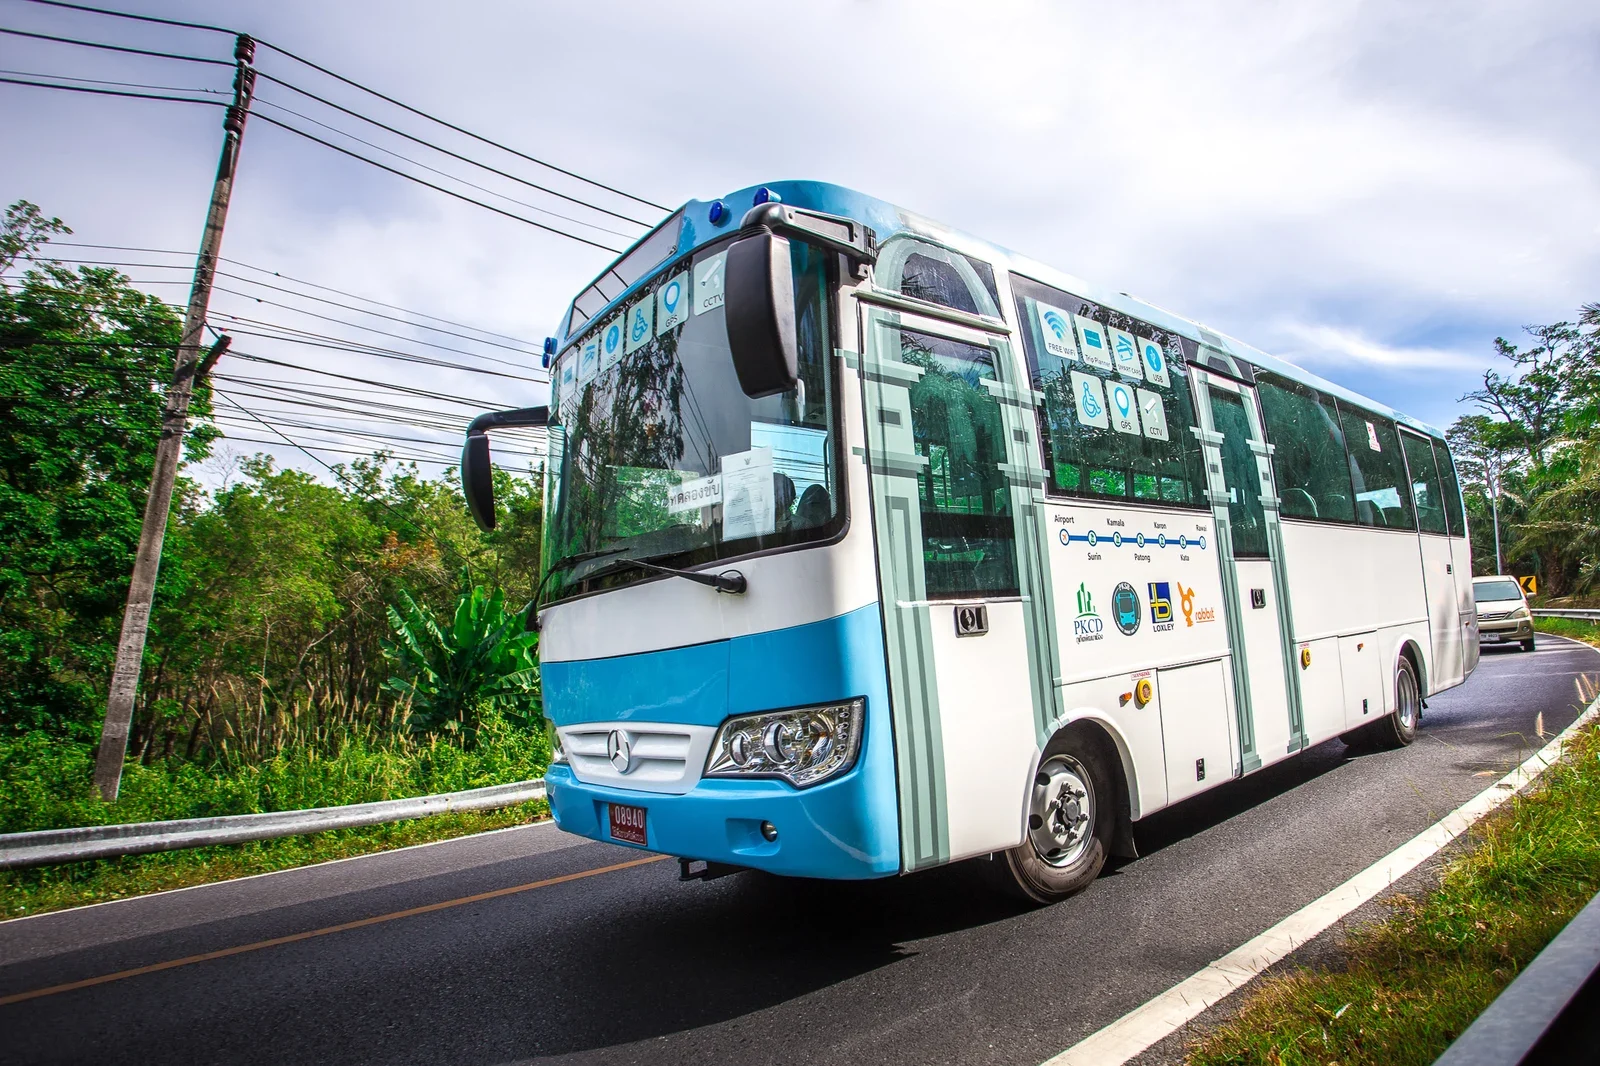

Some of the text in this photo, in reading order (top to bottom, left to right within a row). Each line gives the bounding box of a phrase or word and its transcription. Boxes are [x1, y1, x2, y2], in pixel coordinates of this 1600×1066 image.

[703, 293, 724, 308] CCTV
[665, 314, 678, 328] GPS
[1048, 342, 1063, 353] FREE
[1152, 373, 1164, 383] USB
[1120, 420, 1132, 430] GPS
[1149, 426, 1163, 436] CCTV
[1054, 514, 1075, 525] Airport
[1106, 518, 1125, 527] Kamala
[1153, 521, 1167, 530] Karon
[1087, 552, 1102, 561] Surin
[1134, 553, 1151, 563] Patong
[1180, 554, 1190, 562] Kata
[1195, 607, 1215, 620] rabbit
[1074, 618, 1103, 635] PKCD
[1153, 623, 1175, 633] LOXLEY
